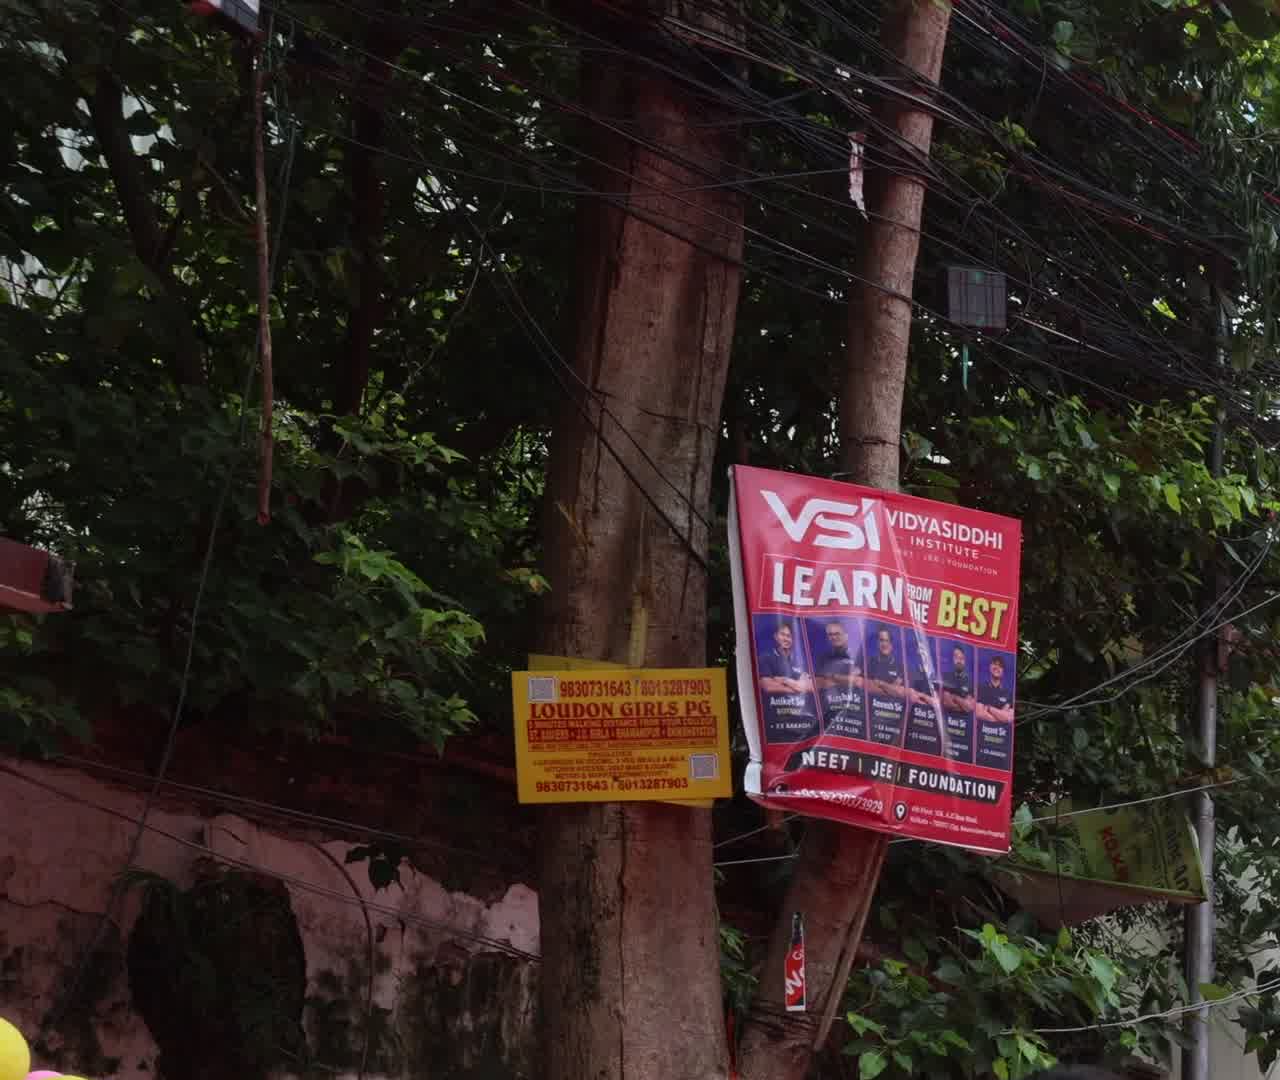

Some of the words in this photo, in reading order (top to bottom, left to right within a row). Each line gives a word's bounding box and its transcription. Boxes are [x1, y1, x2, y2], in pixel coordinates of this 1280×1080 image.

[886, 508, 1003, 550] VIDYASIDDHI
[911, 536, 980, 559] INSTITUTE
[773, 562, 903, 614] LEARN
[906, 582, 933, 603] FROM
[908, 601, 929, 624] THE
[937, 588, 1008, 640] BEST
[560, 680, 631, 698] 9830731643
[531, 702, 614, 719] LOUDON
[620, 702, 679, 718] GIRLS
[686, 700, 711, 716] PG
[536, 779, 608, 793] 9830731643
[801, 749, 849, 771] NEET
[871, 760, 892, 779] JEE
[908, 768, 997, 800] FOUNDATION
